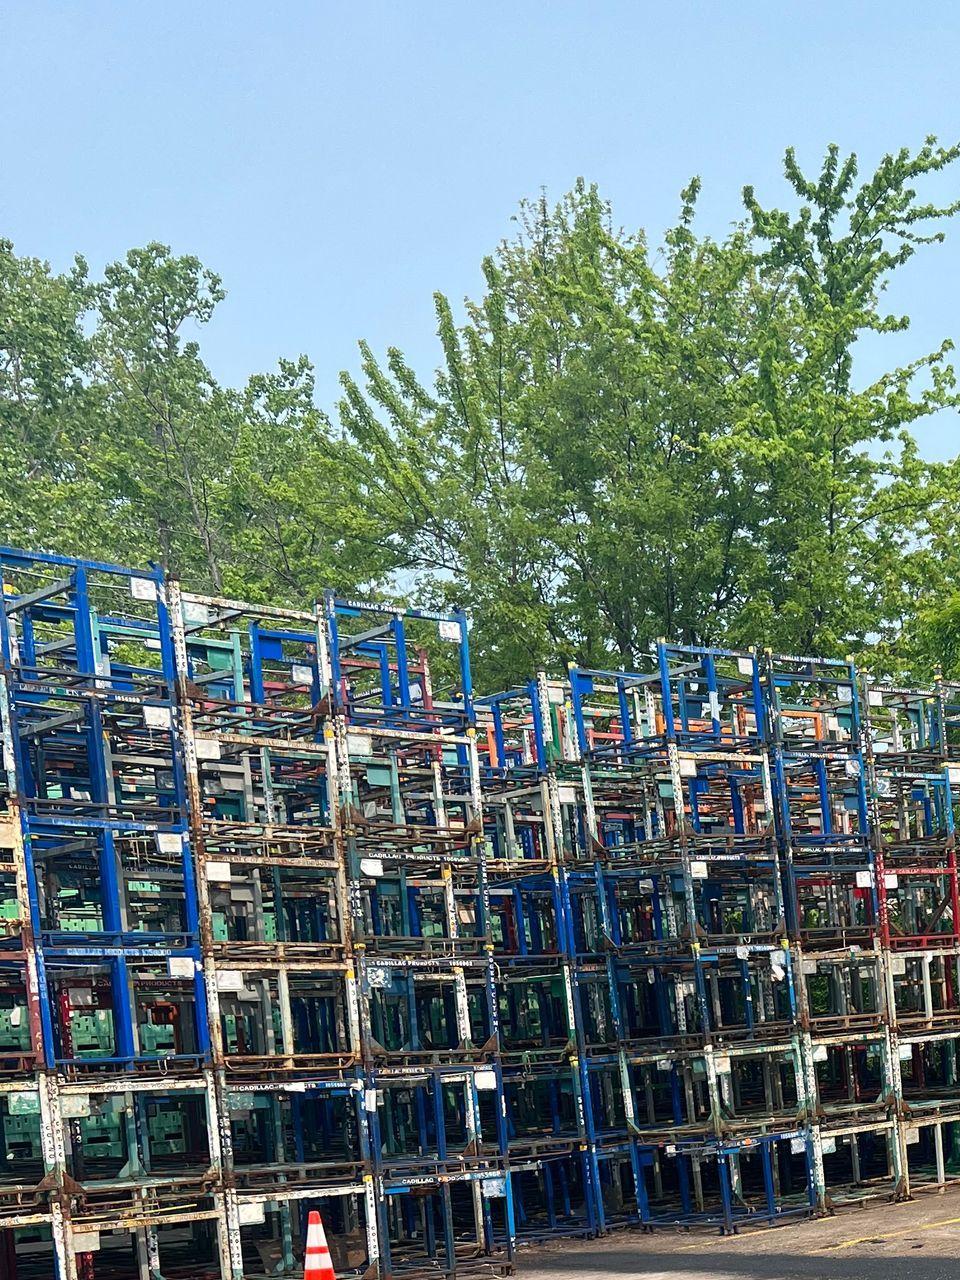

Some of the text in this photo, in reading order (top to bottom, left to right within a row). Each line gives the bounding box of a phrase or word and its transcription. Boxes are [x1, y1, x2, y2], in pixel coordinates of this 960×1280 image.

[348, 600, 379, 611] CADILLAC
[67, 948, 103, 956] CADILLAC
[104, 948, 140, 956] PRODUCTS
[239, 1084, 275, 1092] CADILLAC
